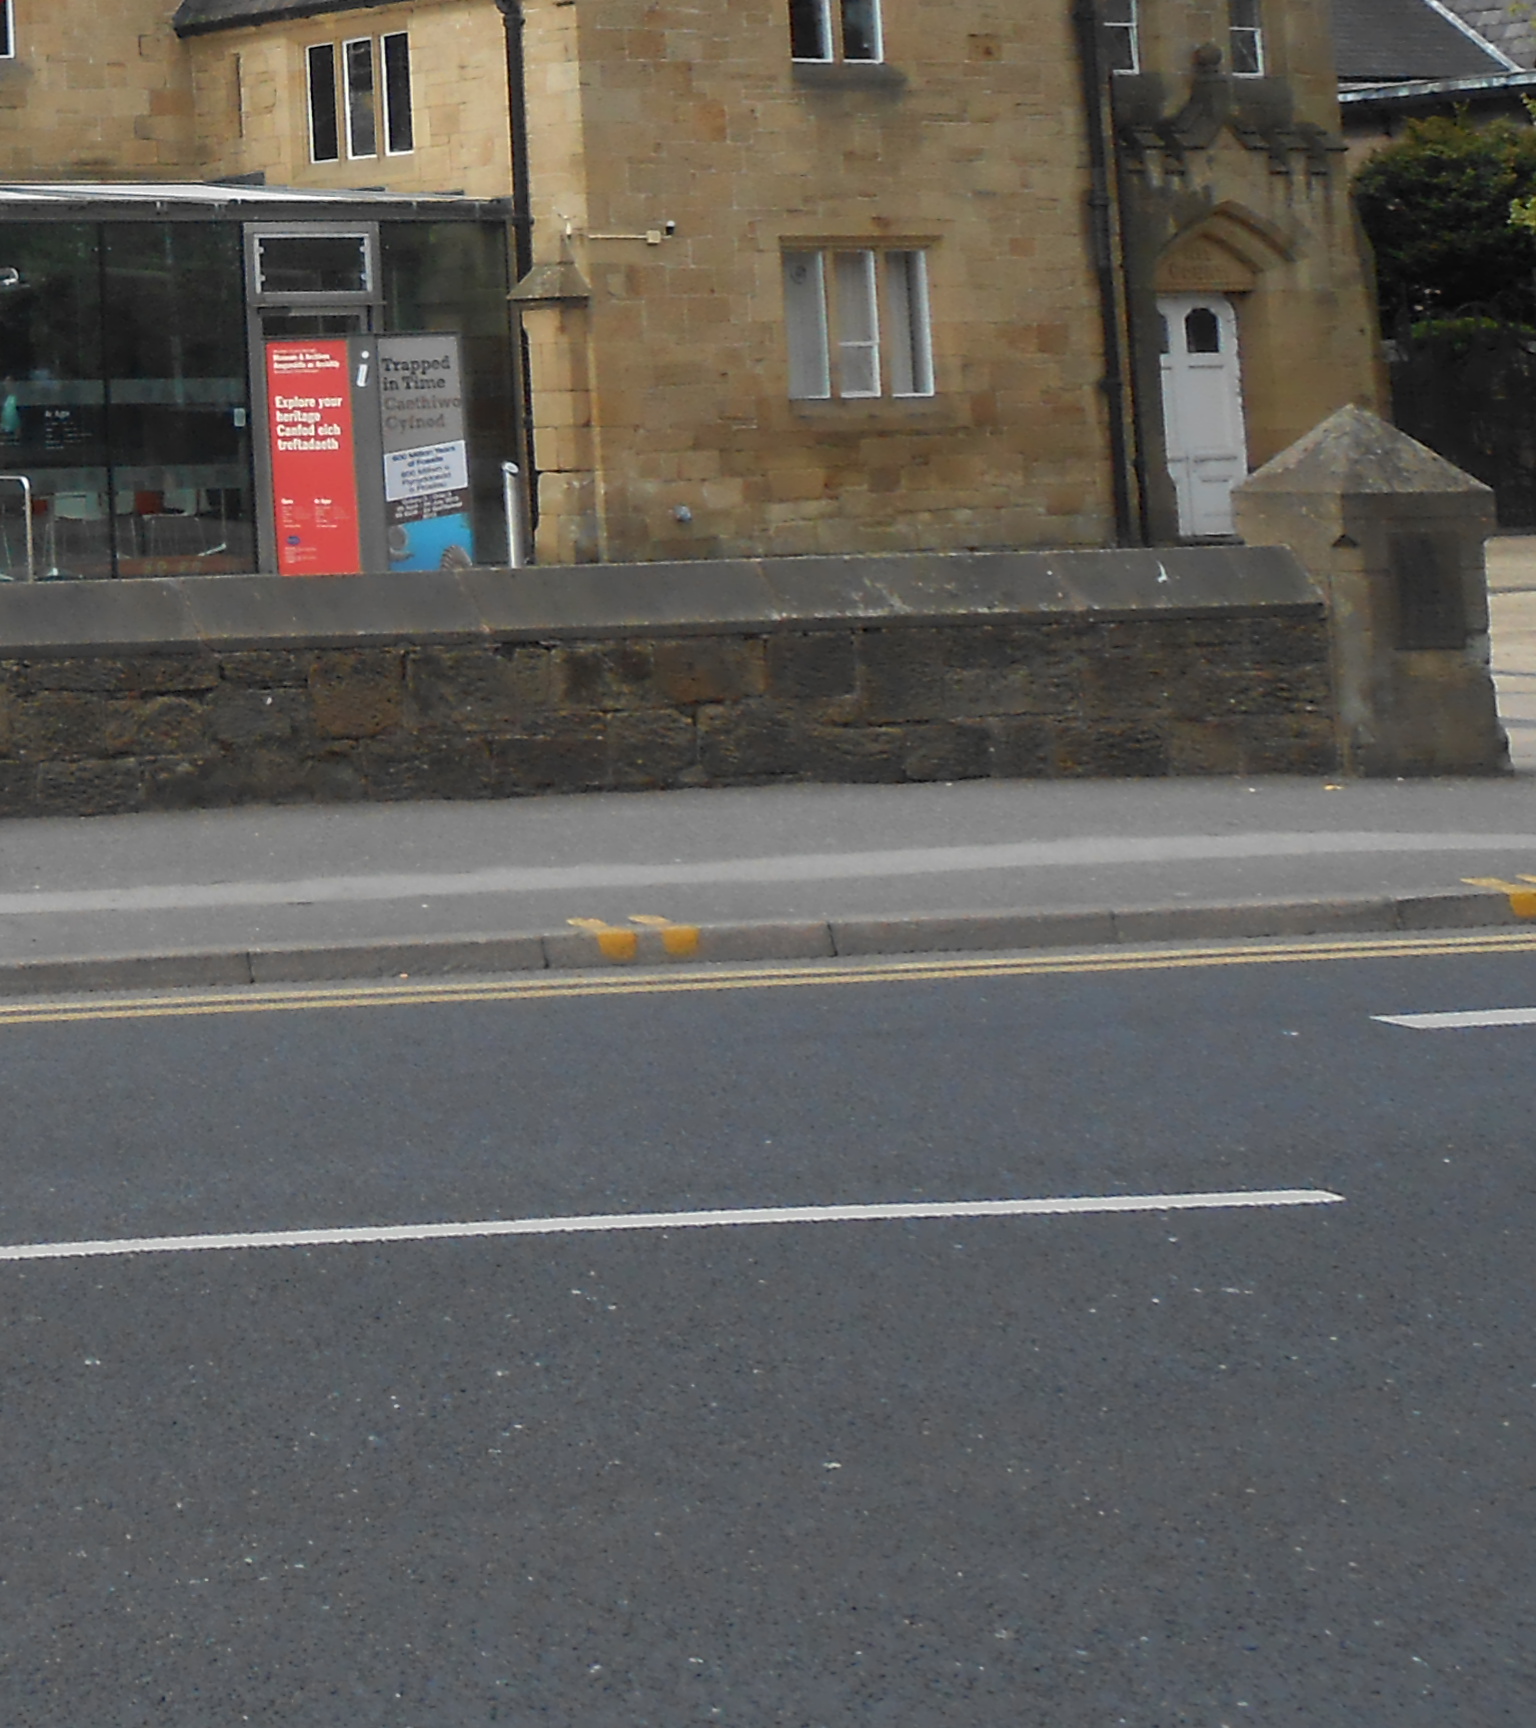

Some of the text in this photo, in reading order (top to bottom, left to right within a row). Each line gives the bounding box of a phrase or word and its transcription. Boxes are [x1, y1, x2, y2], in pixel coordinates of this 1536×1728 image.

[381, 355, 451, 375] Trapped
[383, 376, 446, 391] in Time
[275, 396, 343, 410] Explore your
[276, 410, 321, 423] heritage
[276, 424, 341, 437] Canfod eich
[277, 438, 339, 451] treftadaeth
